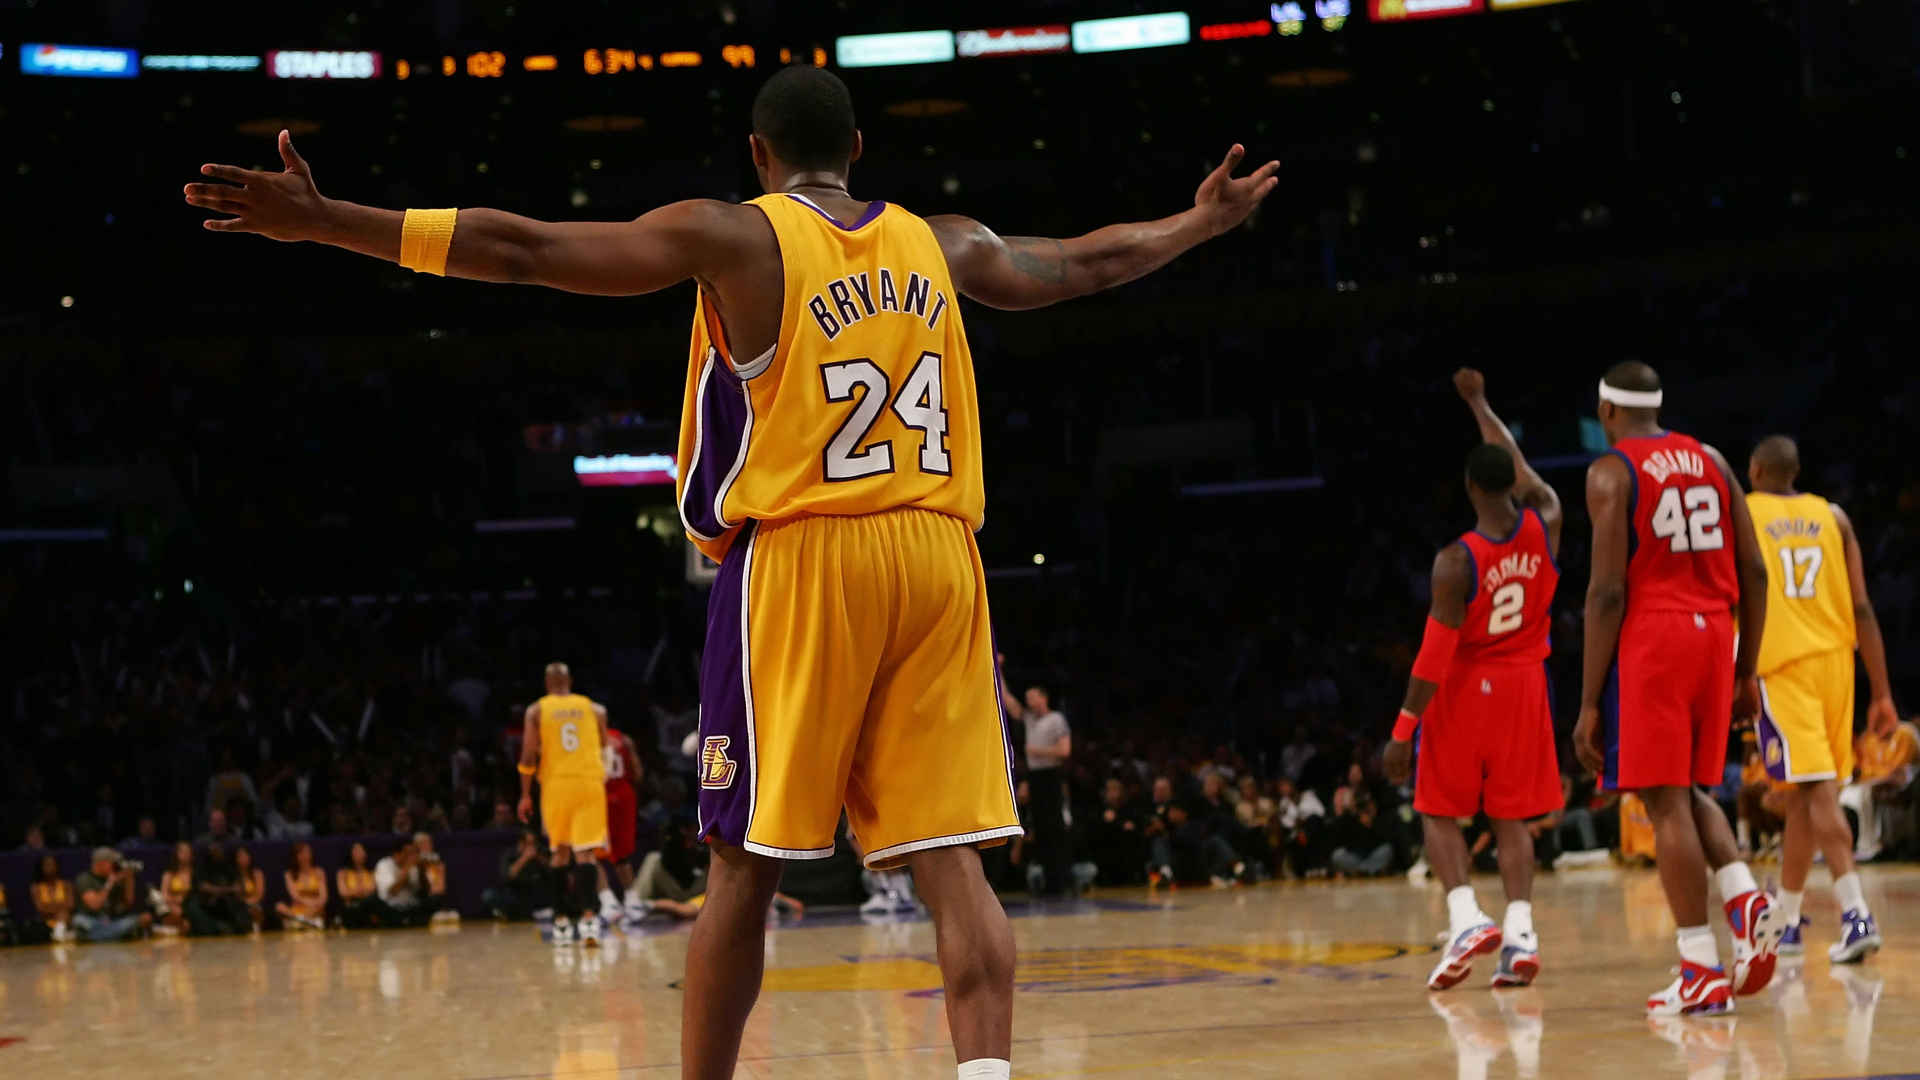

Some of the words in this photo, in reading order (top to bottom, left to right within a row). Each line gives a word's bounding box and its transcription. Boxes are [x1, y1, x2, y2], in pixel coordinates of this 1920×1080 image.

[273, 50, 375, 79] STAPLES
[807, 268, 947, 342] BRYANT
[819, 350, 952, 483] 24
[1642, 447, 1704, 485] BRAND
[1651, 483, 1724, 554] 42
[1779, 545, 1823, 599] 17
[1487, 580, 1525, 636] 2
[561, 722, 580, 752] 6
